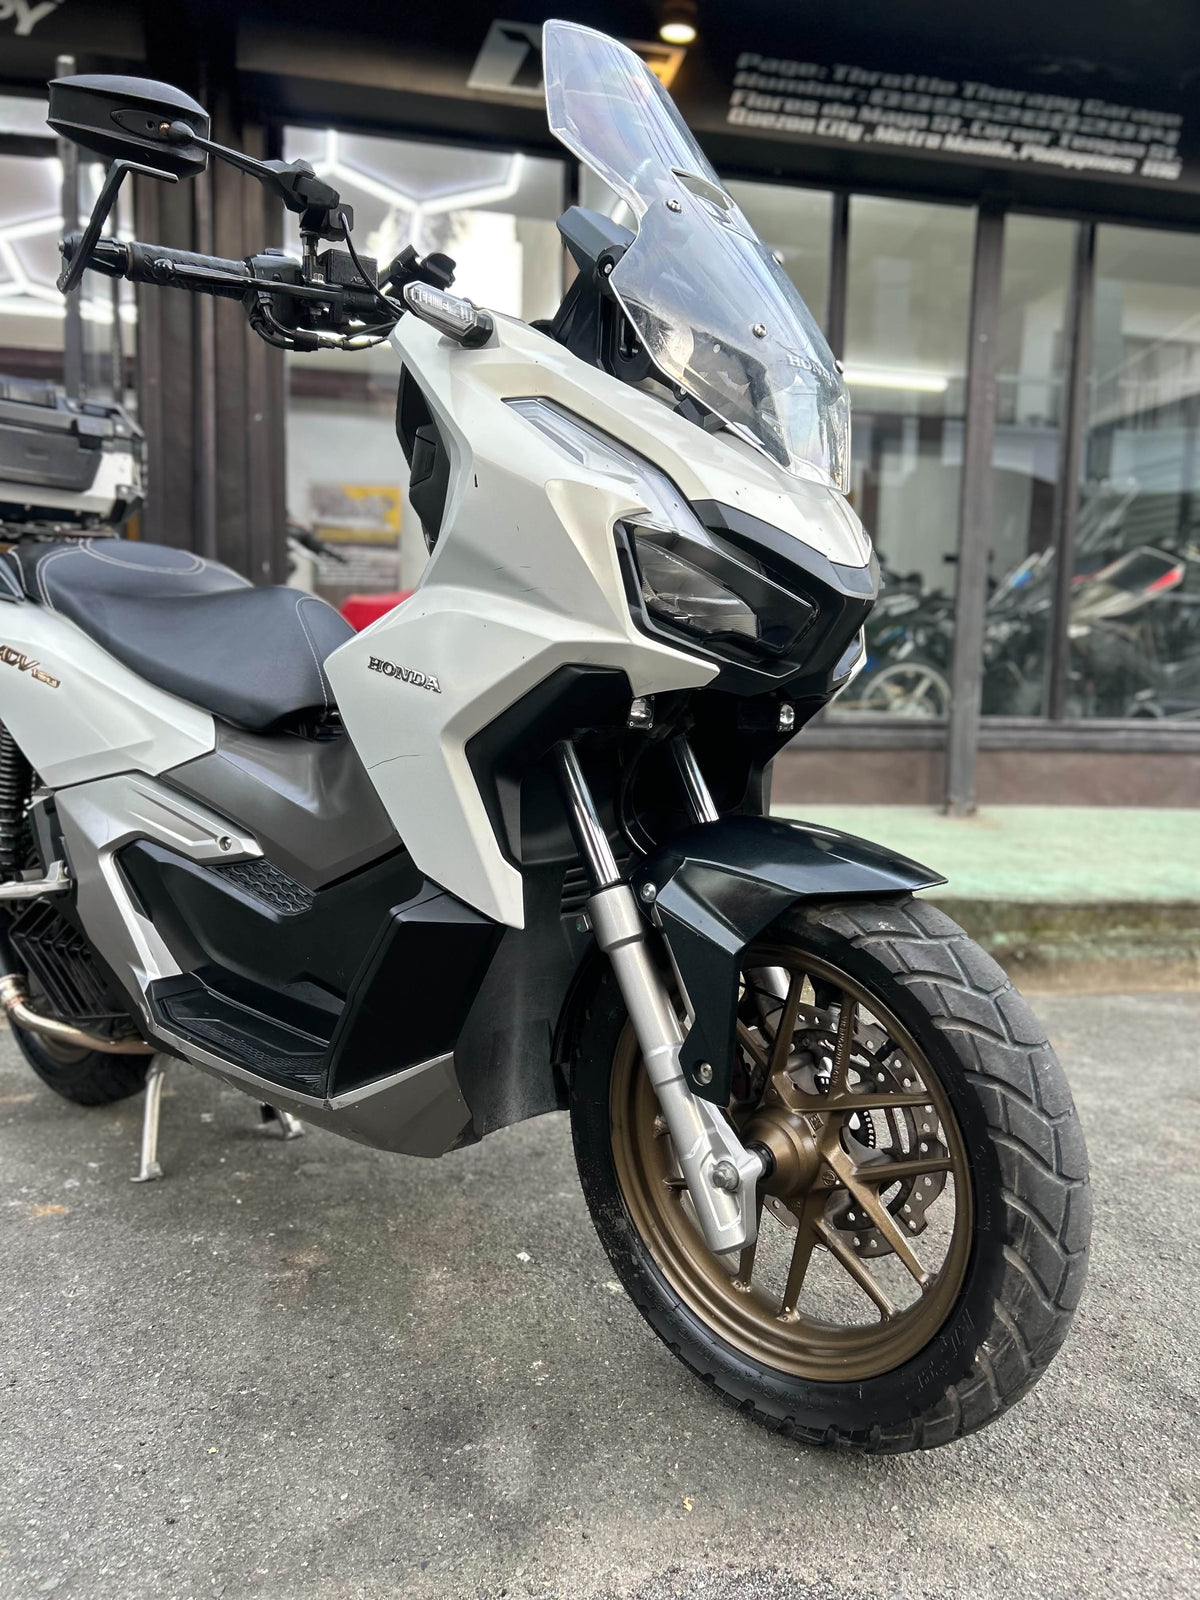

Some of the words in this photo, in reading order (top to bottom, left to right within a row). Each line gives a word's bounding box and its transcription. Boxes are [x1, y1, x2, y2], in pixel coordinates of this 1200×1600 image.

[832, 64, 957, 96] Throttle
[727, 106, 815, 133] Quezon
[873, 126, 942, 150] Metro
[731, 89, 818, 114] Flores
[821, 101, 856, 119] de
[858, 106, 929, 129] Mayo
[368, 656, 442, 694] HONDA
